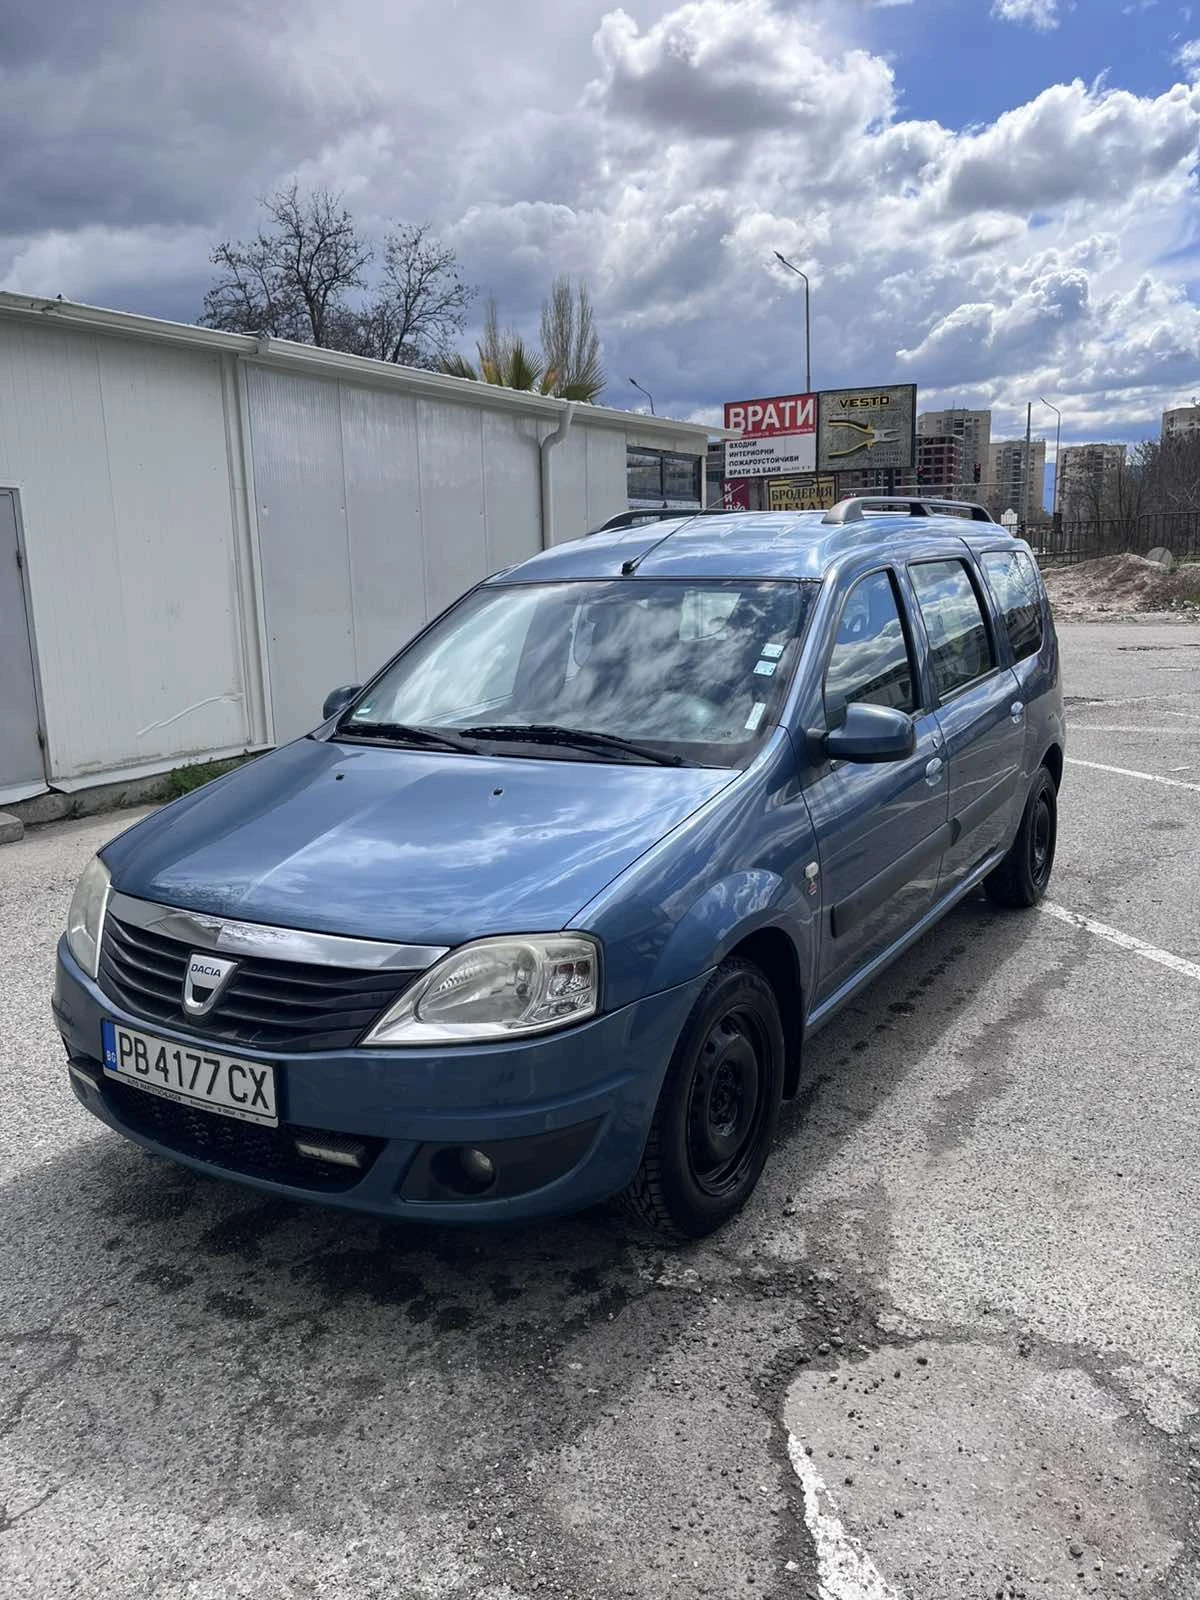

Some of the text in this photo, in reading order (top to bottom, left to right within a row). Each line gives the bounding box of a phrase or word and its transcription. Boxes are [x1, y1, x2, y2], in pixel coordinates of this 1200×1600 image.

[839, 395, 890, 409] VESTO
[728, 398, 815, 433] ВРАТИ
[728, 440, 758, 450] ВХОДНИ
[728, 448, 775, 459] ИНТЕРИОРНИ
[728, 455, 800, 468] ПОЖАРОУСТОЙЧИВИ
[728, 468, 751, 477] ВРАТИ
[752, 467, 761, 475] ЗА
[762, 465, 782, 475] БАНЯ
[771, 486, 833, 501] БРОДЕРИЯ
[191, 963, 221, 977] DACIA
[106, 1050, 117, 1064] BG
